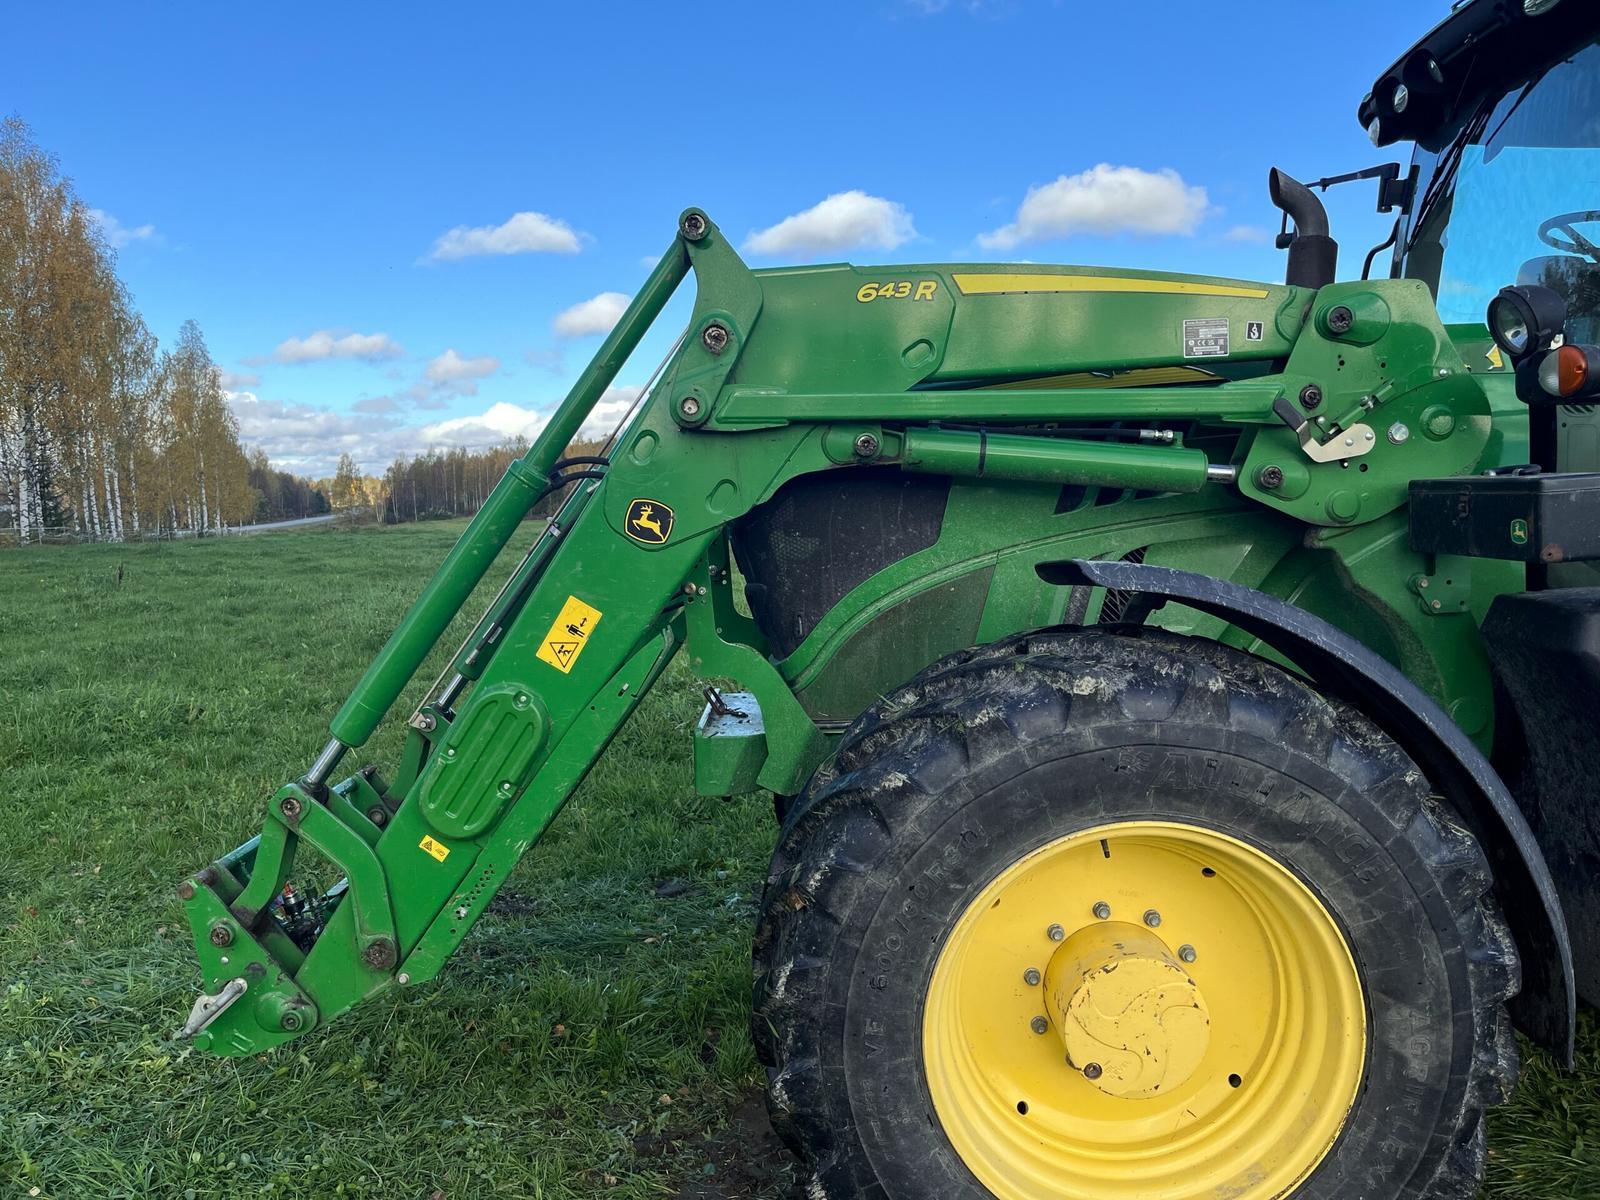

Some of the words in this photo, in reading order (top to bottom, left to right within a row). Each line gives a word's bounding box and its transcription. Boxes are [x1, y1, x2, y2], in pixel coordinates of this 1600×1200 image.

[856, 281, 913, 303] 643
[913, 279, 938, 301] R
[1150, 752, 1396, 884] ALLIANCE
